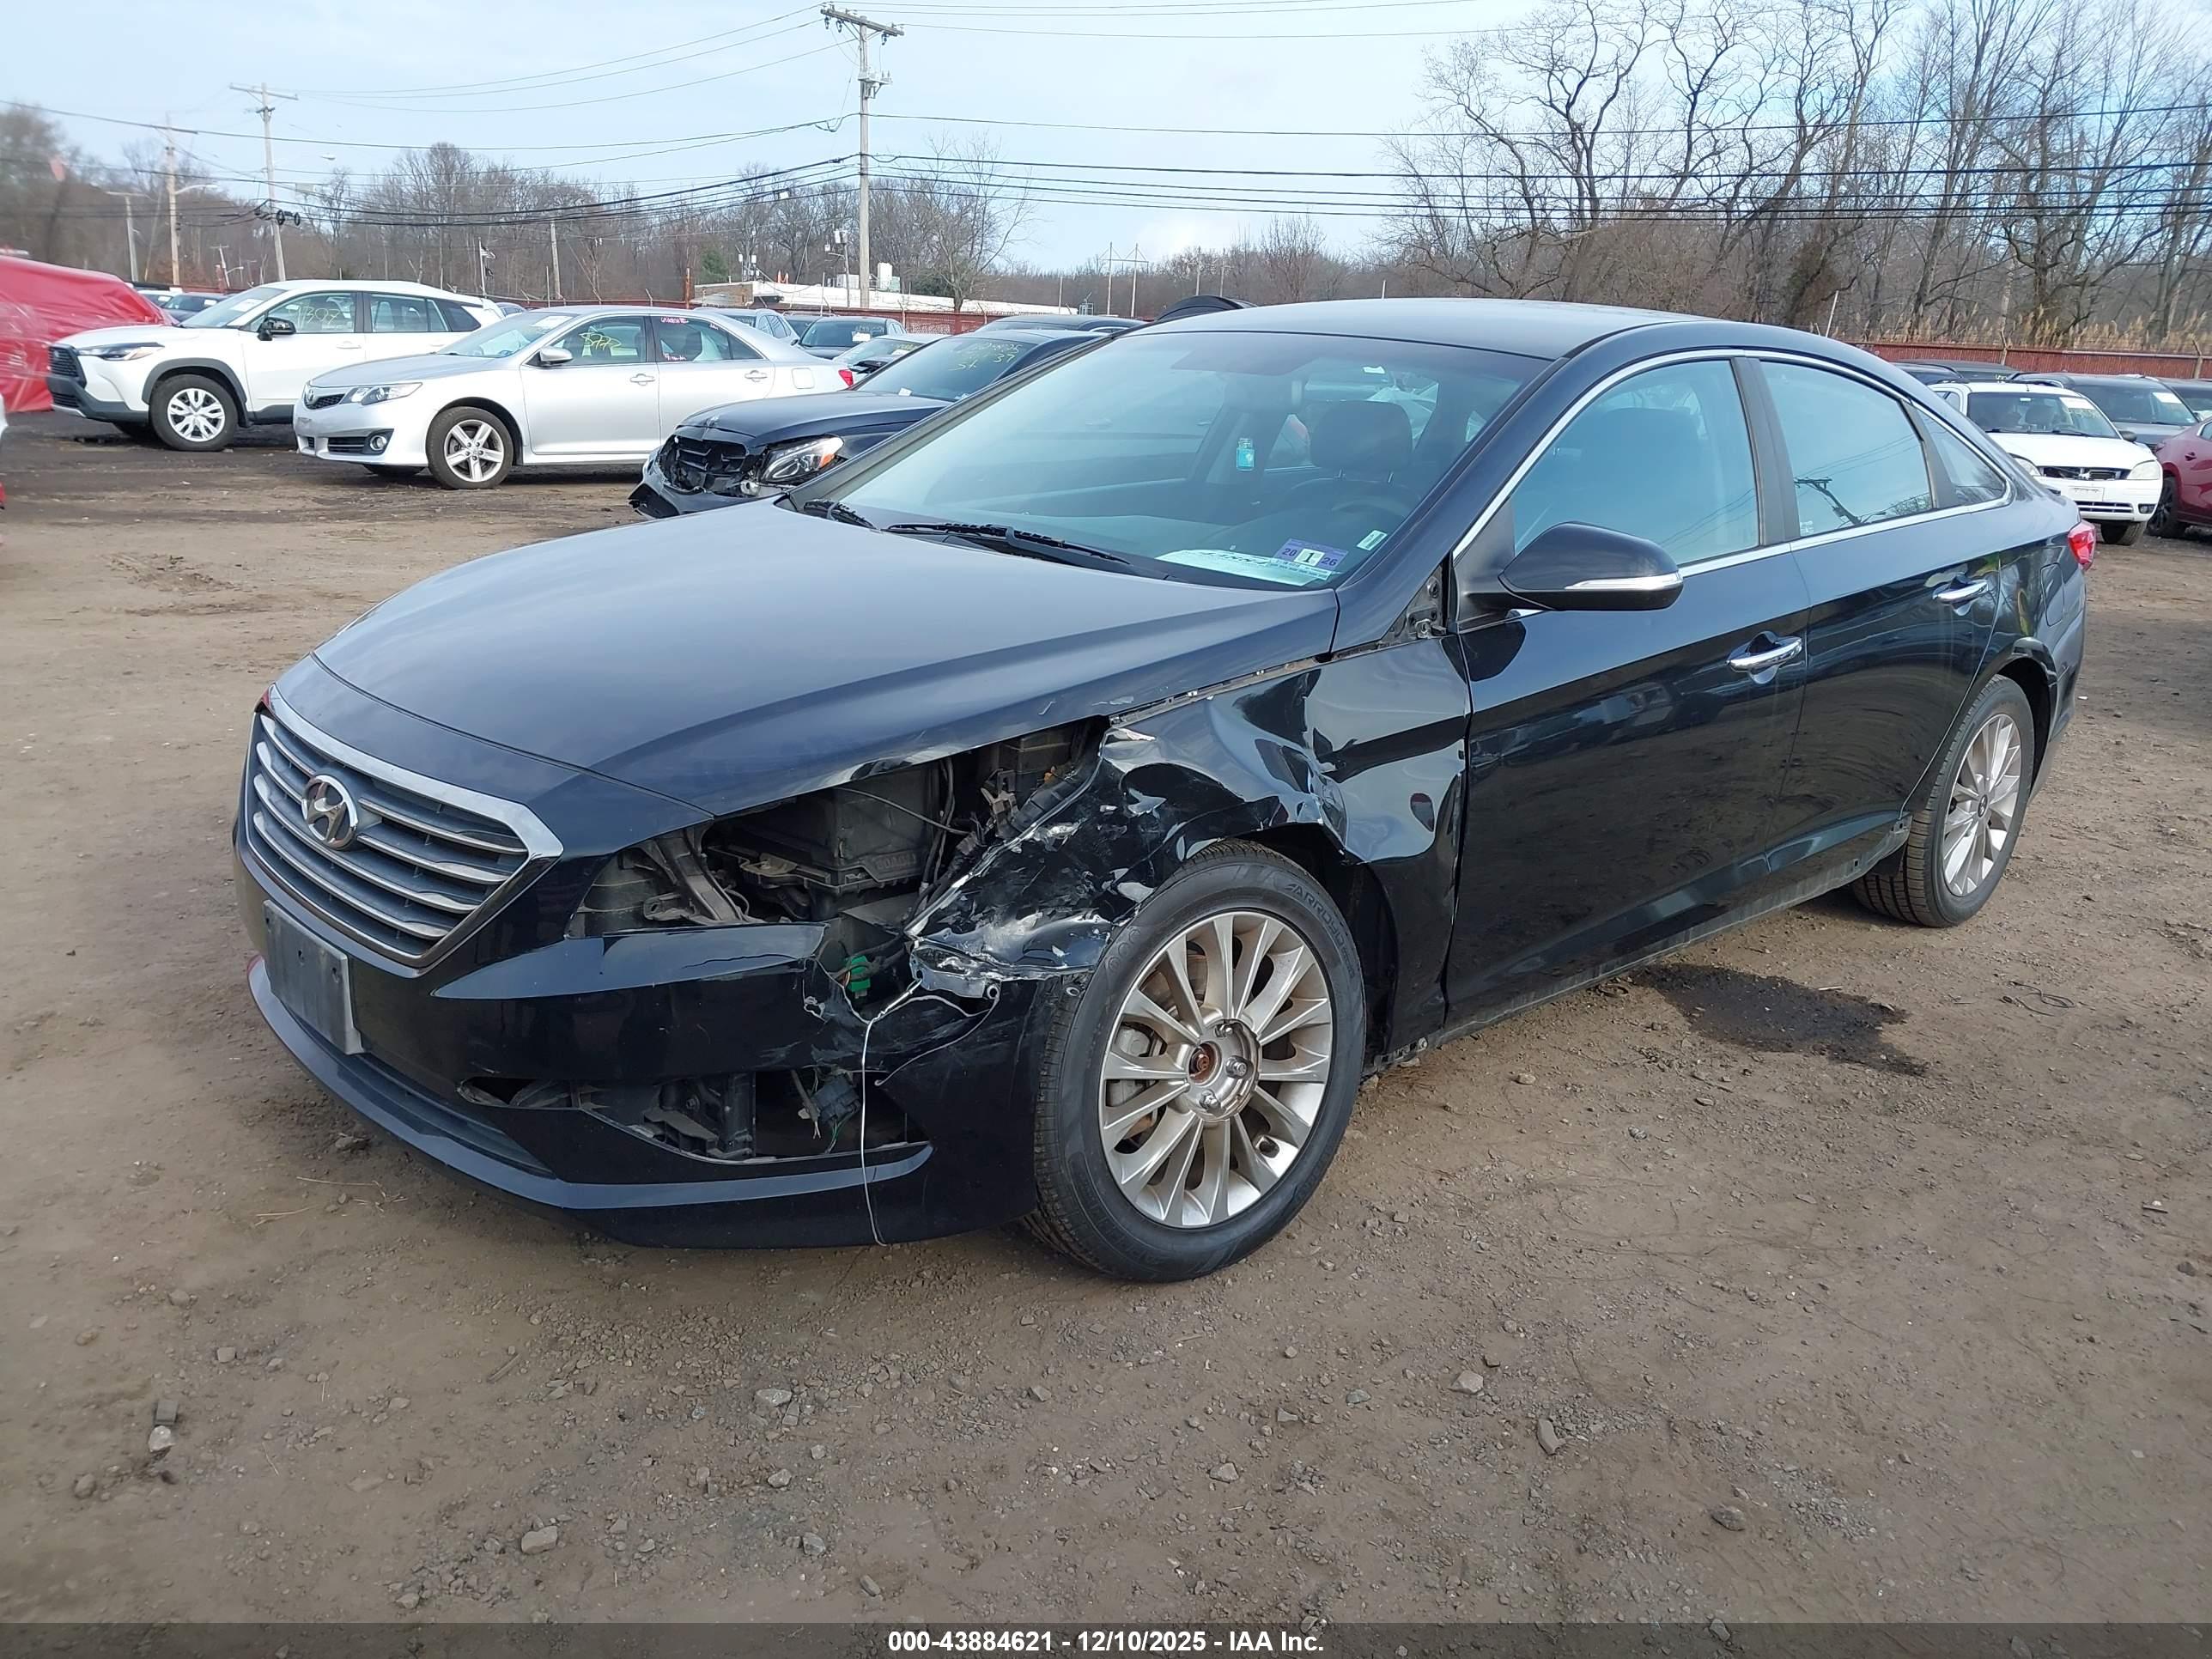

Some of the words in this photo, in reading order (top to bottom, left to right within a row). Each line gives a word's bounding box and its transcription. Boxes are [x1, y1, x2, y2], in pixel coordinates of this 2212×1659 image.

[1281, 548, 1298, 557] 20
[1303, 552, 1315, 563] 1
[1321, 556, 1338, 567] 26
